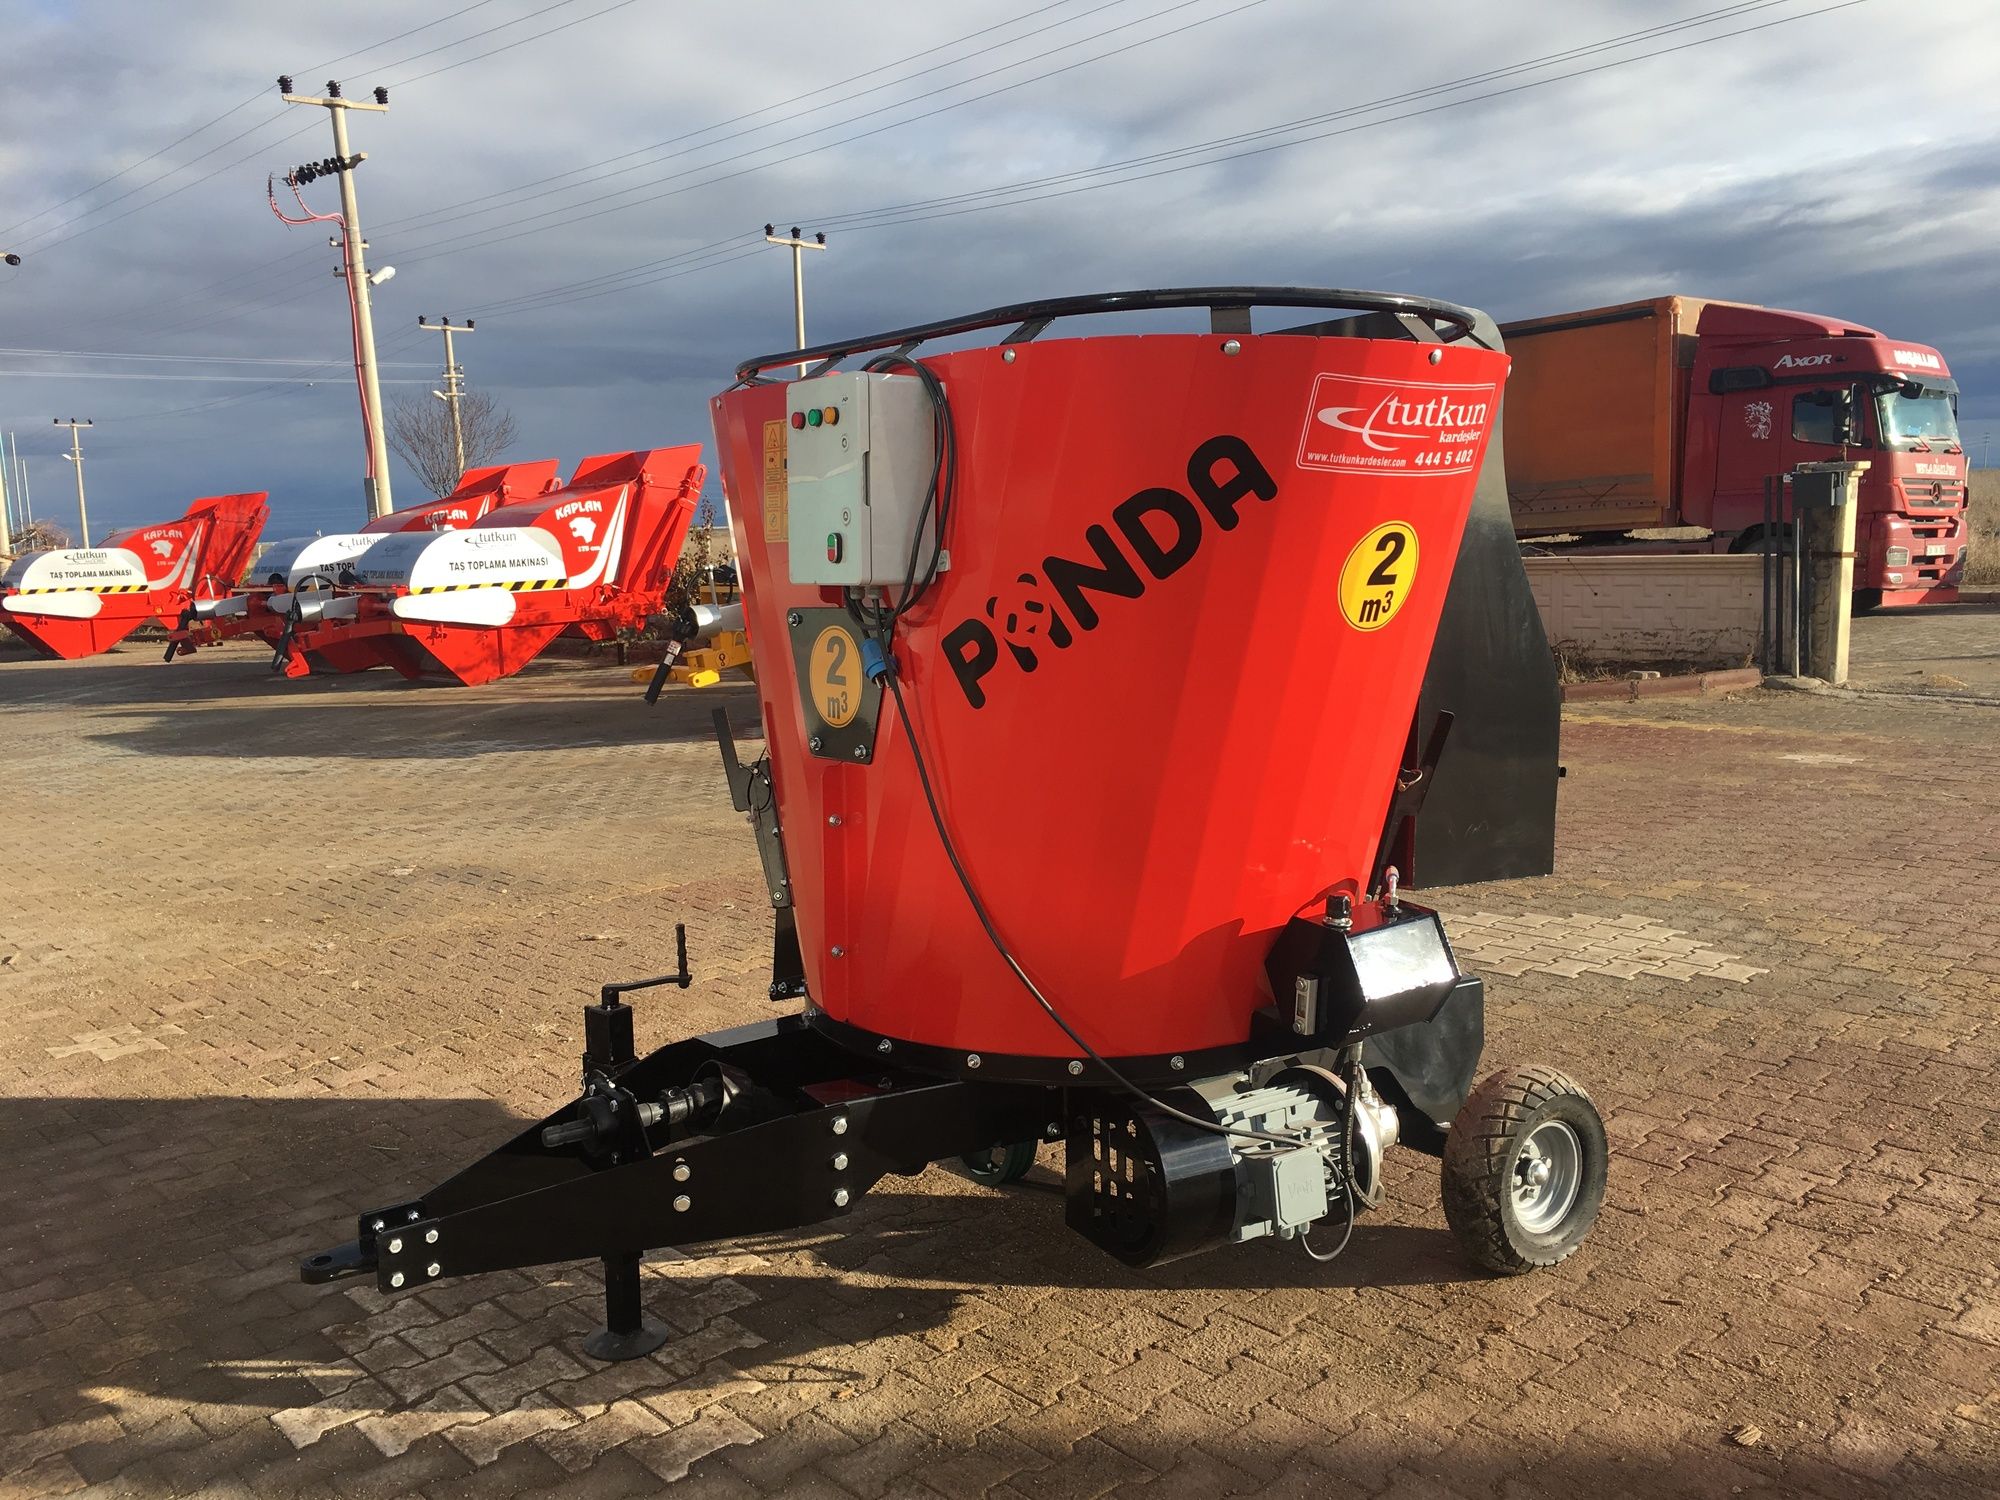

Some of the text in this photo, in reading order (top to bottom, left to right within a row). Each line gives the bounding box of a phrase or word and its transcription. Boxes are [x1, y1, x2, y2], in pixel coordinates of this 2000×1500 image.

[1386, 395, 1487, 427] tutkun
[1439, 429, 1482, 444] kardeşler
[1307, 452, 1406, 468] www.tutkunkardesler.com
[1415, 449, 1474, 466] 444 5 402
[424, 509, 469, 525] KAPLAN
[555, 500, 603, 520] KAPLAN
[143, 529, 183, 541] KAPLAN
[479, 531, 517, 543] tutkun
[75, 551, 108, 560] tutkun
[1366, 531, 1406, 586] 2
[468, 559, 507, 570] TOPLAMA
[941, 435, 1278, 709] PANDA
[65, 570, 97, 579] TOPLAMA
[825, 635, 847, 686] 2
